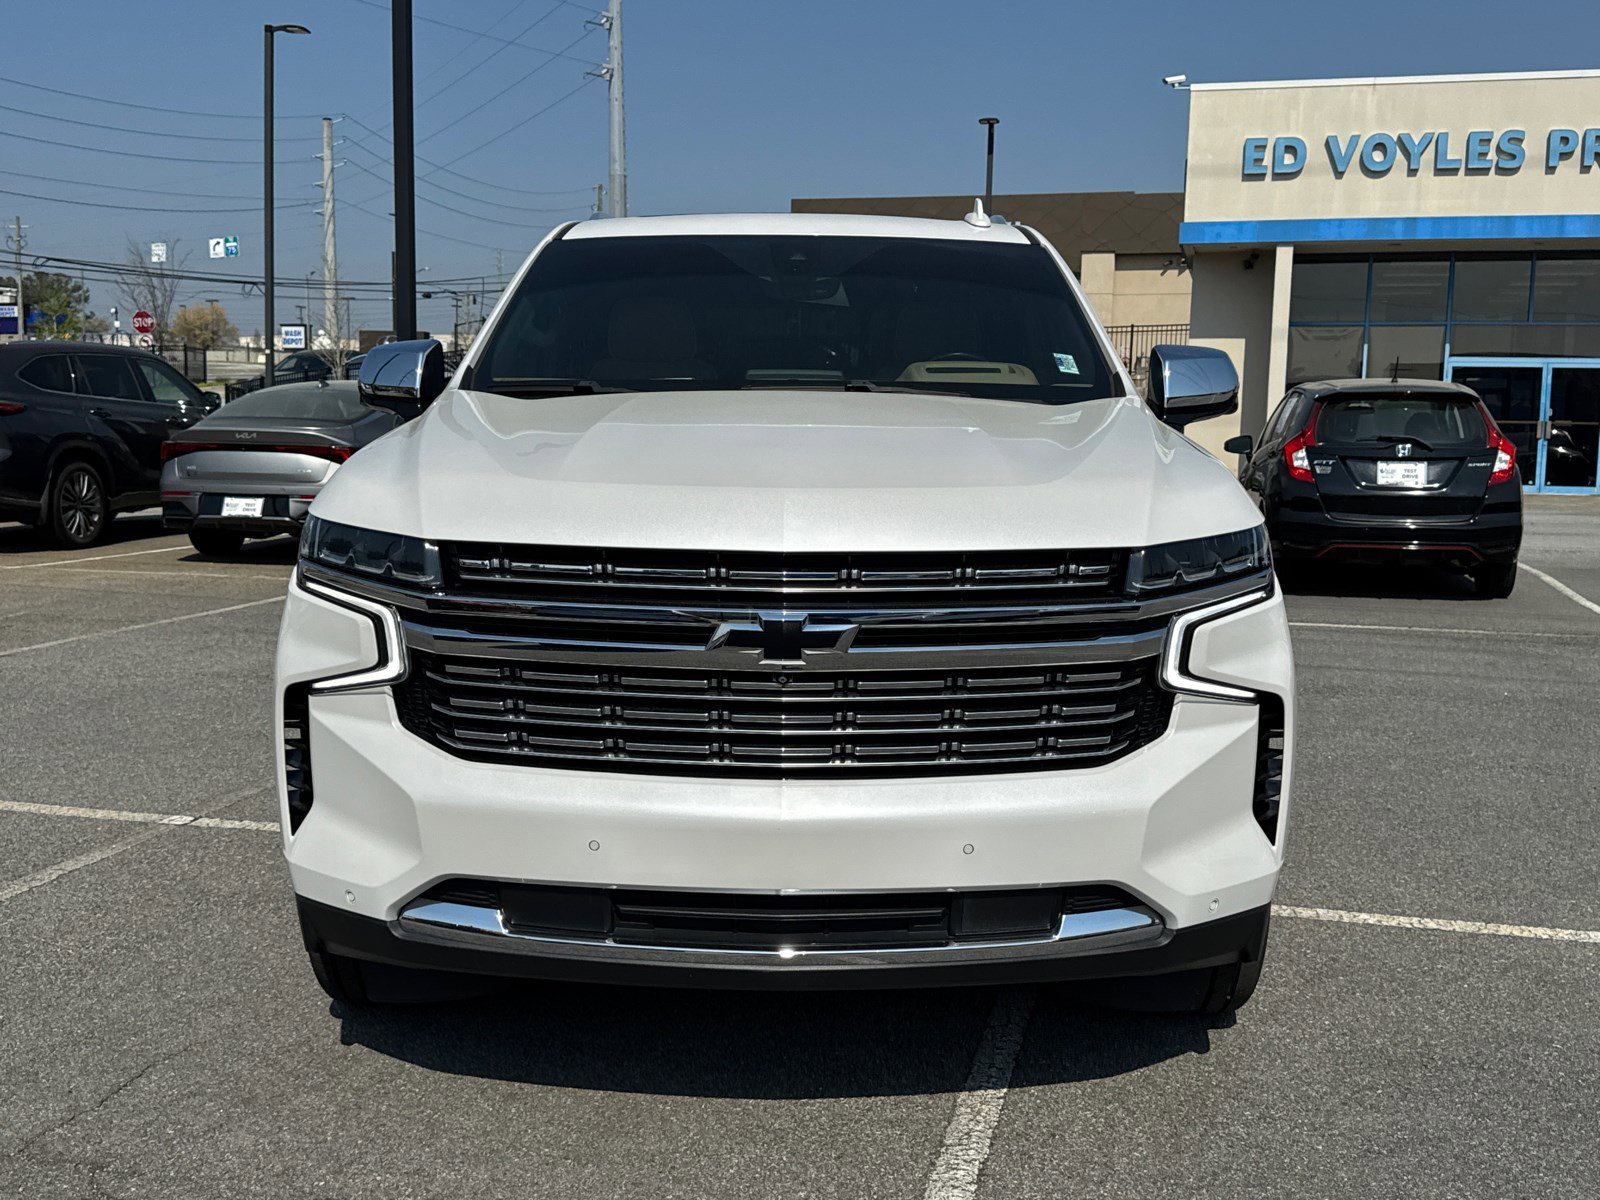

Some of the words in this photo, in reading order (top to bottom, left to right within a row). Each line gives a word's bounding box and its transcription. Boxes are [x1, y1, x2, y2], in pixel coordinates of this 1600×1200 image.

[1242, 137, 1307, 179] ED
[1325, 130, 1526, 178] VOYLES
[133, 317, 153, 327] STOP
